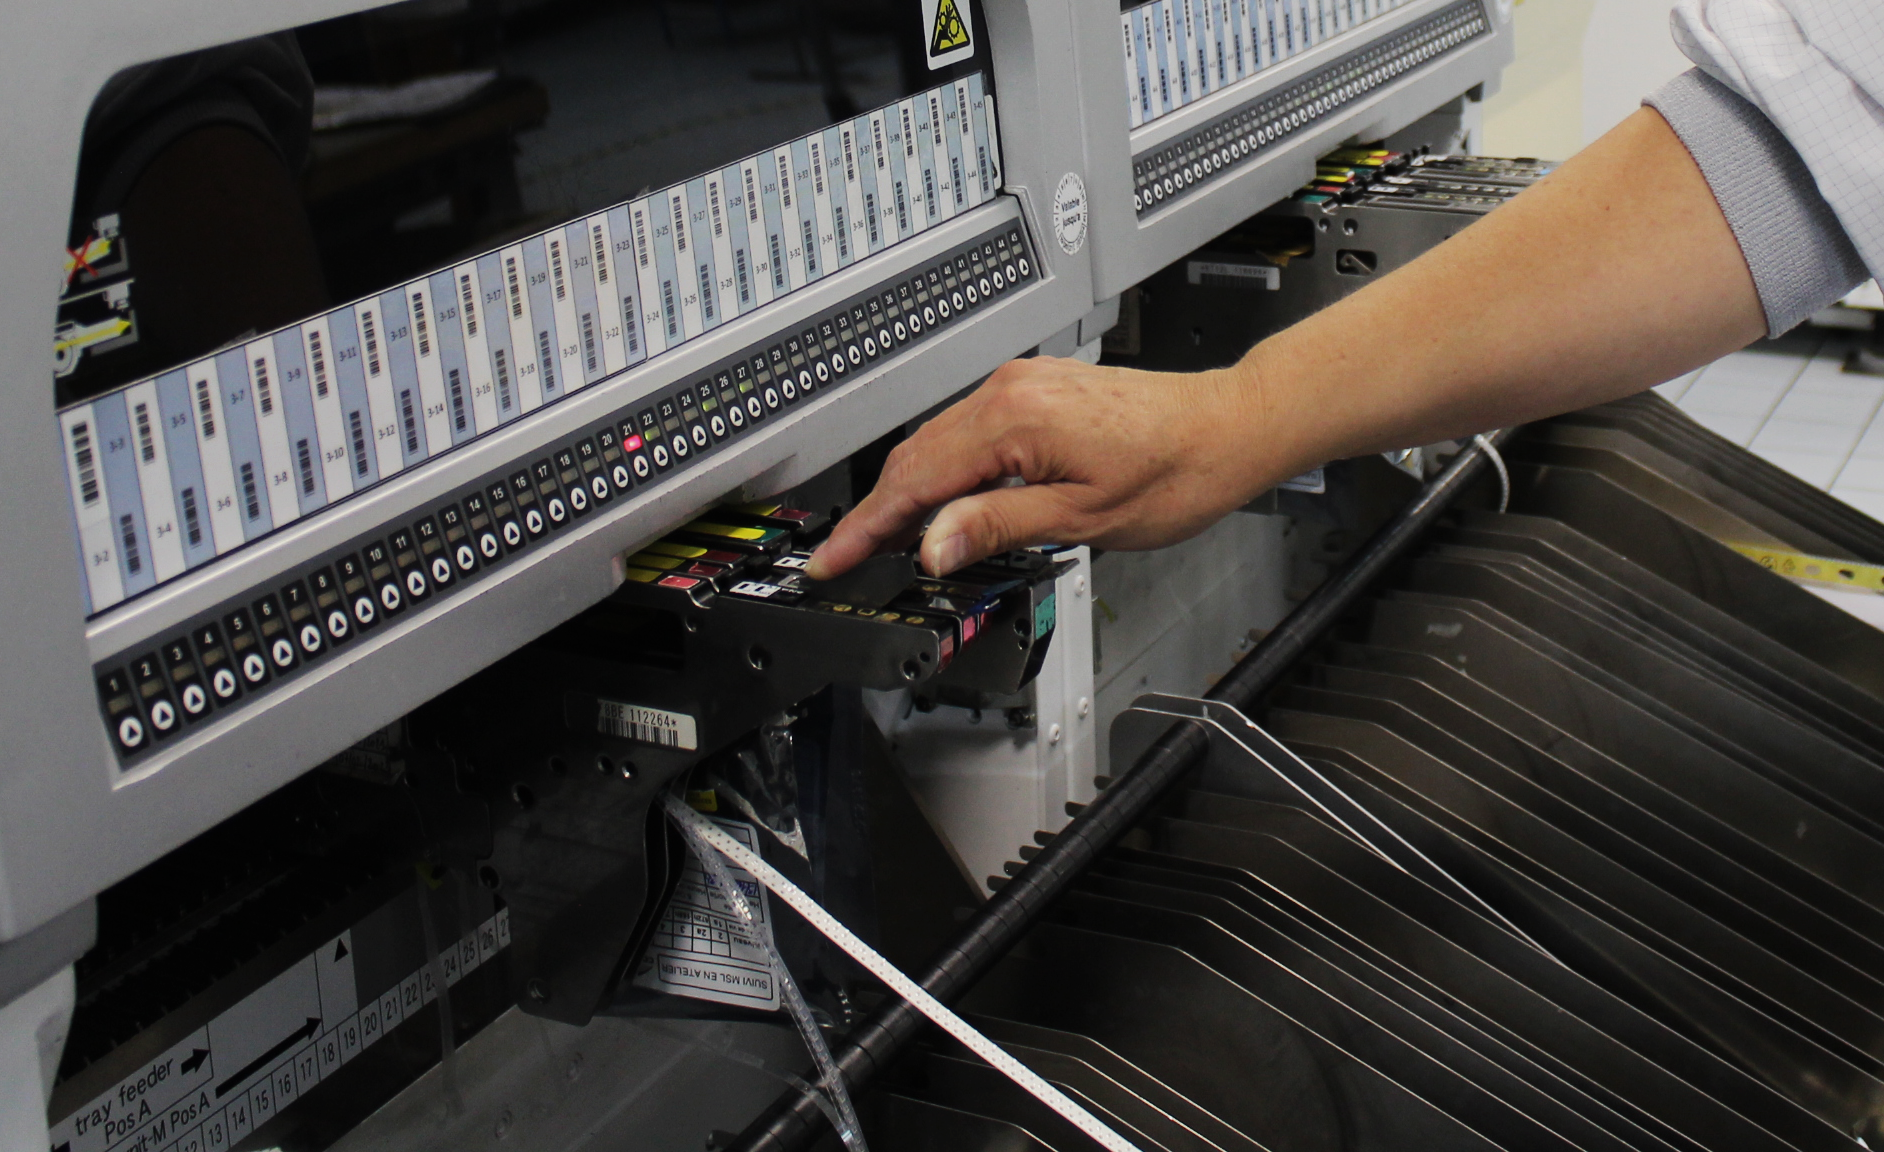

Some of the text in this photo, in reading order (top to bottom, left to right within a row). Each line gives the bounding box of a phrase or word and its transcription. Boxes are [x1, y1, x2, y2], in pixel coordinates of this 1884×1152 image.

[1061, 198, 1080, 212] Valable
[172, 413, 186, 428] 3-5
[231, 389, 244, 404] 3-7
[288, 368, 301, 382] 3-9
[340, 347, 356, 361] 3-11
[391, 327, 407, 341] 3-13
[440, 308, 455, 322] 3-15
[487, 289, 500, 303] 3-17
[531, 273, 545, 285] 3-19
[575, 256, 588, 268] 3-21
[616, 240, 630, 252] 3-23
[656, 225, 668, 237] 3-25
[694, 211, 704, 222] 3-27
[730, 197, 741, 208] 3-29
[94, 550, 109, 566] 3-2
[157, 523, 172, 538] 3-4
[217, 496, 231, 511] 3-6
[275, 472, 287, 485] 3-8
[326, 447, 343, 462] 3-10
[379, 425, 395, 439] 3-12
[428, 404, 443, 417] 3-14
[476, 383, 490, 397] 3-16
[521, 363, 534, 377] 3-18
[563, 345, 577, 358] 3-20
[606, 327, 619, 339] 3-22
[647, 311, 659, 323] 3-24
[685, 294, 696, 306] 3-26
[721, 278, 732, 290] 3-28
[109, 678, 119, 690] 1
[141, 662, 151, 676] 2
[172, 648, 182, 660] 3
[204, 632, 213, 644] 4
[233, 618, 243, 630] 5
[262, 604, 271, 616] 6
[290, 588, 298, 600] 7
[318, 576, 327, 588] 8
[345, 562, 353, 574] 9
[370, 548, 382, 562] 10
[396, 536, 406, 548] 11
[420, 522, 432, 536] 12
[446, 510, 456, 524] 13
[470, 498, 480, 512] 14
[492, 488, 504, 500] 15
[516, 476, 526, 488] 16
[538, 464, 546, 478] 17
[560, 454, 570, 466] 18
[582, 444, 592, 456] 19
[602, 434, 612, 446] 20
[622, 424, 632, 436] 21
[642, 414, 652, 426] 22
[662, 404, 672, 416] 23
[682, 394, 692, 406] 24
[700, 384, 710, 396] 25
[718, 376, 728, 388] 26
[738, 366, 746, 378] 27
[754, 358, 764, 370] 28
[772, 350, 781, 360] 29
[789, 342, 798, 352] 30
[805, 334, 815, 344] 31
[822, 324, 832, 336] 32
[838, 316, 848, 328] 33
[854, 310, 863, 320] 34
[869, 302, 879, 312] 35
[697, 928, 707, 937] 2a
[661, 964, 768, 989] SUIVI MSL EN ATELIER
[208, 1124, 223, 1147] 13
[232, 1106, 246, 1130] 14
[255, 1090, 269, 1114] 15
[278, 1074, 292, 1097] 16
[300, 1057, 312, 1081] 17
[322, 1042, 335, 1066] 18
[344, 1028, 356, 1049] 19
[364, 1012, 377, 1036] 20
[385, 998, 397, 1020] 21
[405, 983, 418, 1006] 22
[444, 956, 456, 977] 24
[464, 941, 475, 964] 25
[482, 928, 494, 950] 26
[500, 916, 509, 937] 2
[74, 1058, 174, 1136] tray feeder
[104, 1099, 152, 1144] Pos A
[127, 1091, 211, 1152] nit-M Pos A
